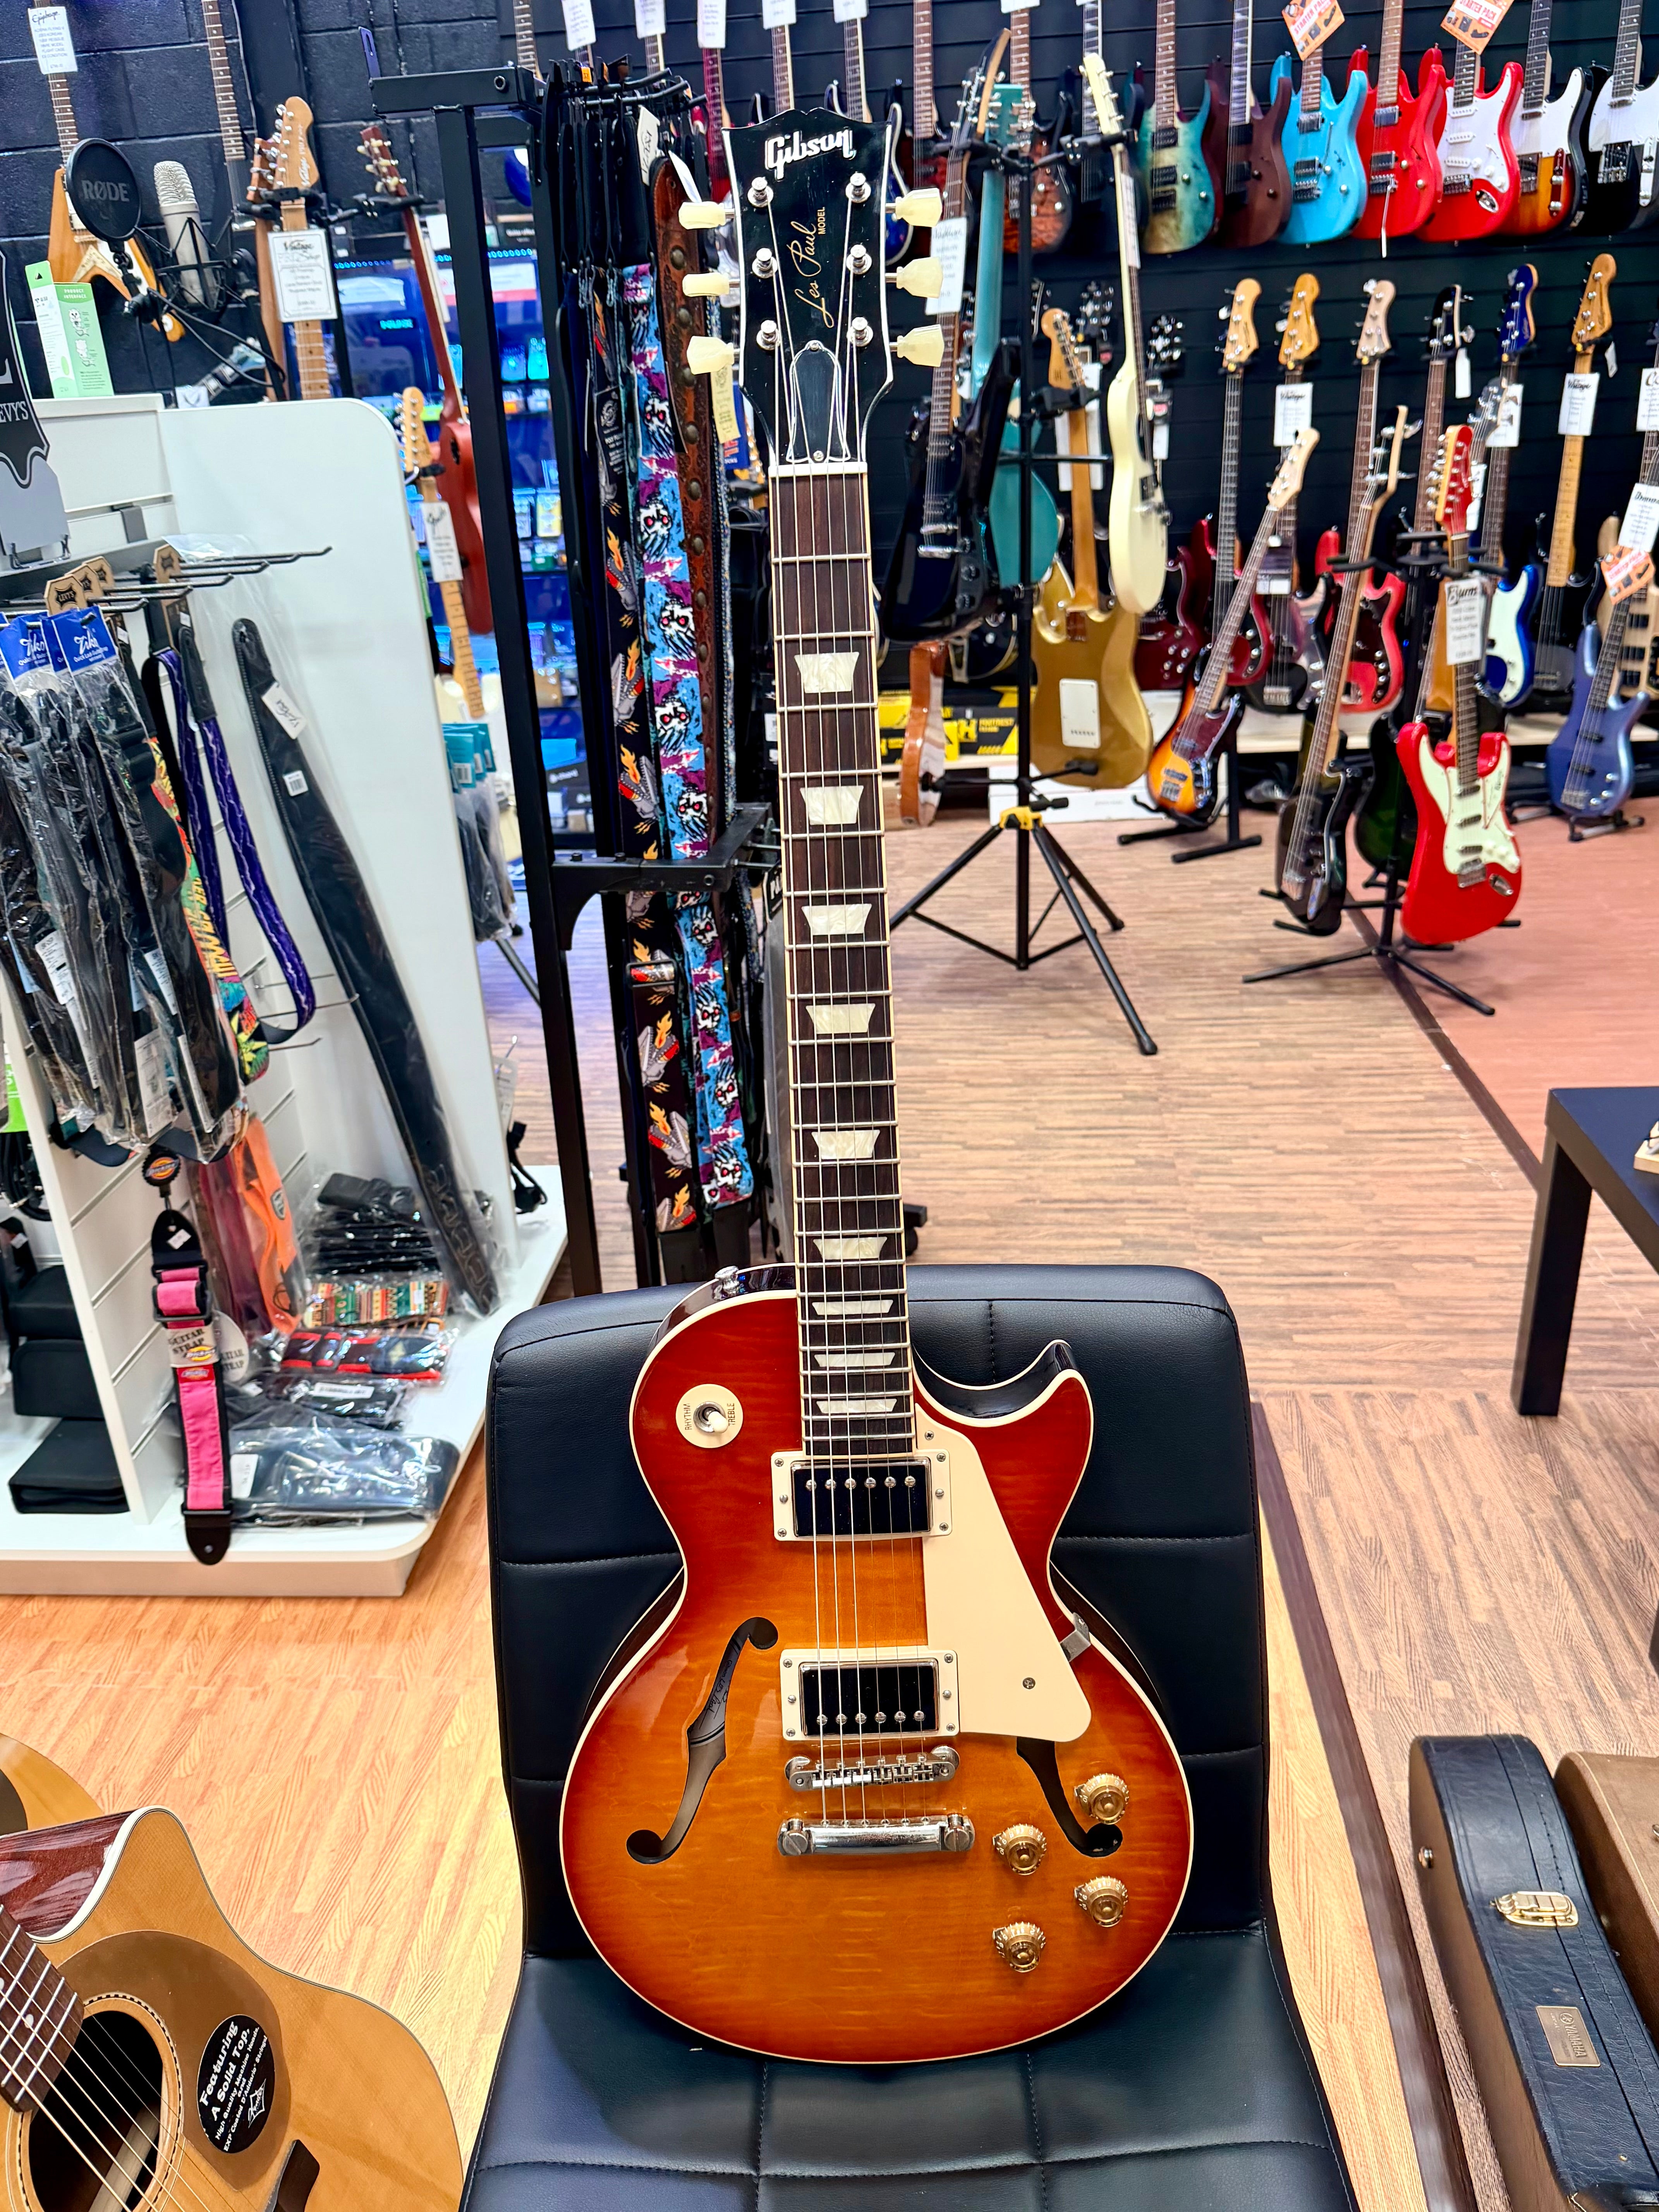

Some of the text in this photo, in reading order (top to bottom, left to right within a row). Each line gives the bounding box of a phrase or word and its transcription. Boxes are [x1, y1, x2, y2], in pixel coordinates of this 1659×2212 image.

[765, 129, 857, 182] Gibson
[81, 180, 130, 202] RØDE
[787, 221, 834, 328] Les Paul
[168, 1328, 205, 1345] GUITAR
[173, 1338, 204, 1354] STRAP
[683, 1403, 692, 1430] RHYTHM
[727, 1403, 736, 1426] TREBLE
[721, 1660, 732, 1678] Gibson
[1565, 2025, 1587, 2057] YAMAHA
[199, 2021, 238, 2106] Featuring
[211, 2028, 250, 2121] A Solid Top,
[215, 2027, 260, 2140] High Quality Machine Heads,
[231, 2105, 244, 2133] Coated
[255, 2035, 268, 2063] Strings!
[237, 2078, 247, 2097] and
